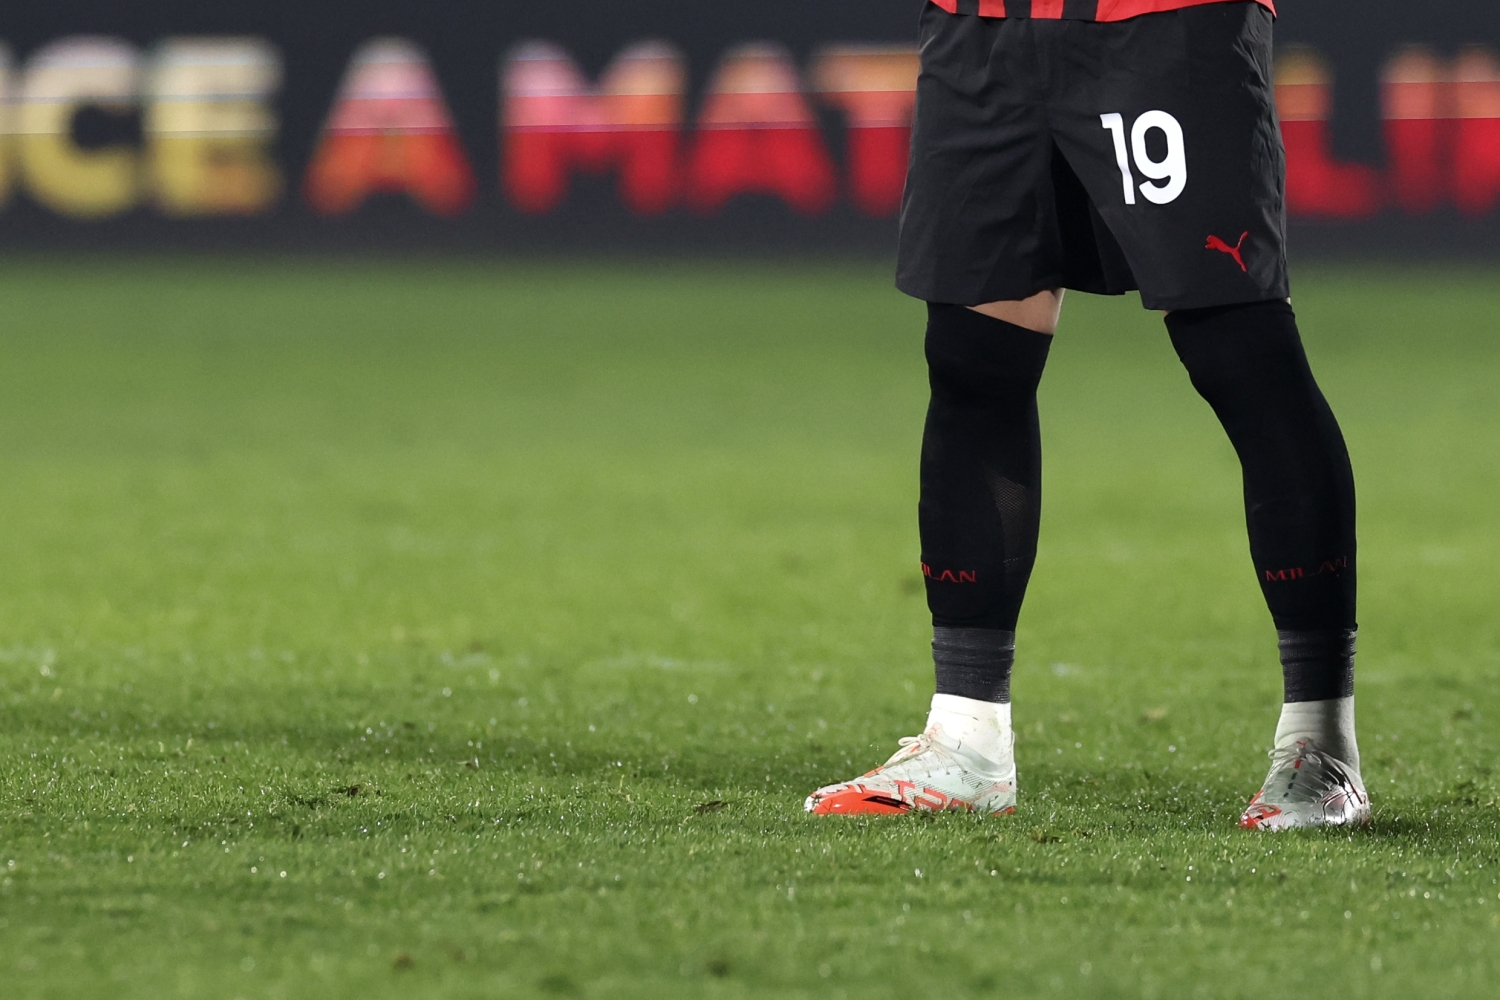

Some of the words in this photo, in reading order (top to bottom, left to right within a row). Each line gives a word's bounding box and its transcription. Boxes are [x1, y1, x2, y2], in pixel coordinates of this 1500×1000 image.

[0, 37, 283, 218] CE
[305, 37, 476, 217] A
[500, 40, 919, 219] MAT
[1100, 110, 1187, 204] 19
[920, 561, 977, 583] ILAN
